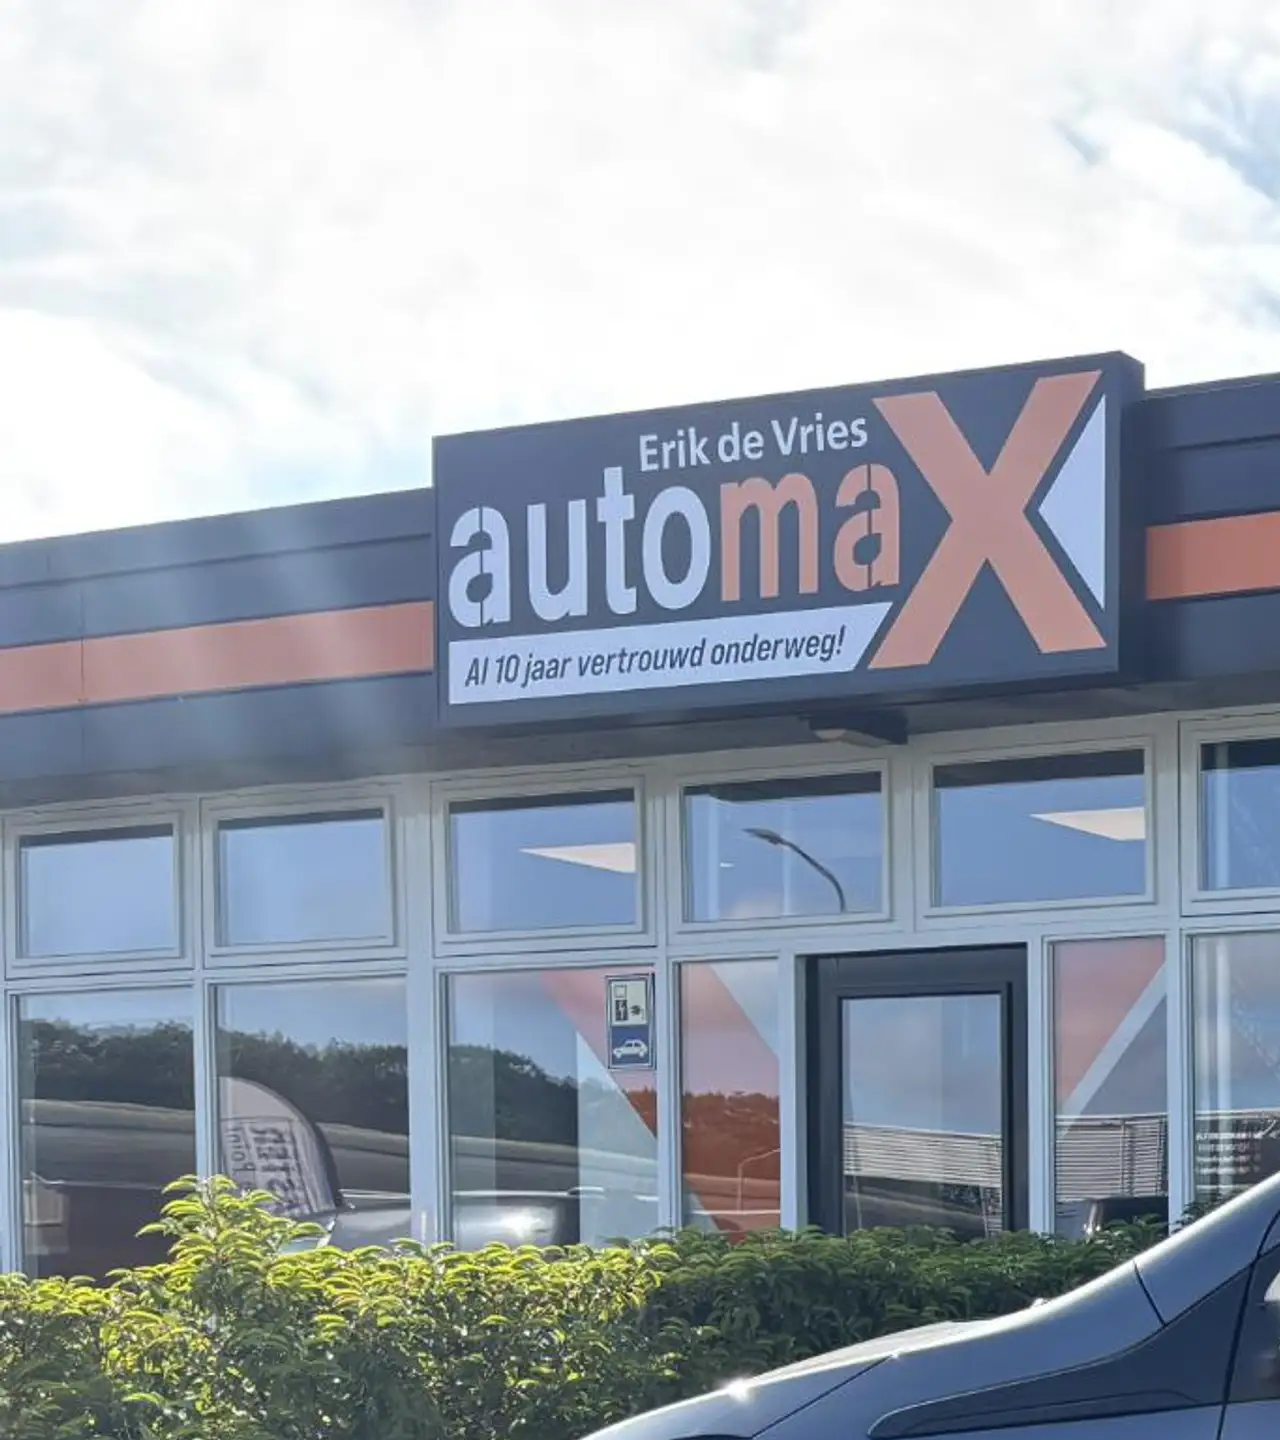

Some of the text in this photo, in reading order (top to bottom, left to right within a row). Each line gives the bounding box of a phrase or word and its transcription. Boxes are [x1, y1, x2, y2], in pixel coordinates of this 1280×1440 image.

[639, 412, 868, 472] Erik de Vries
[464, 624, 846, 689] Al 10 jaar vertrouwd onderweg!
